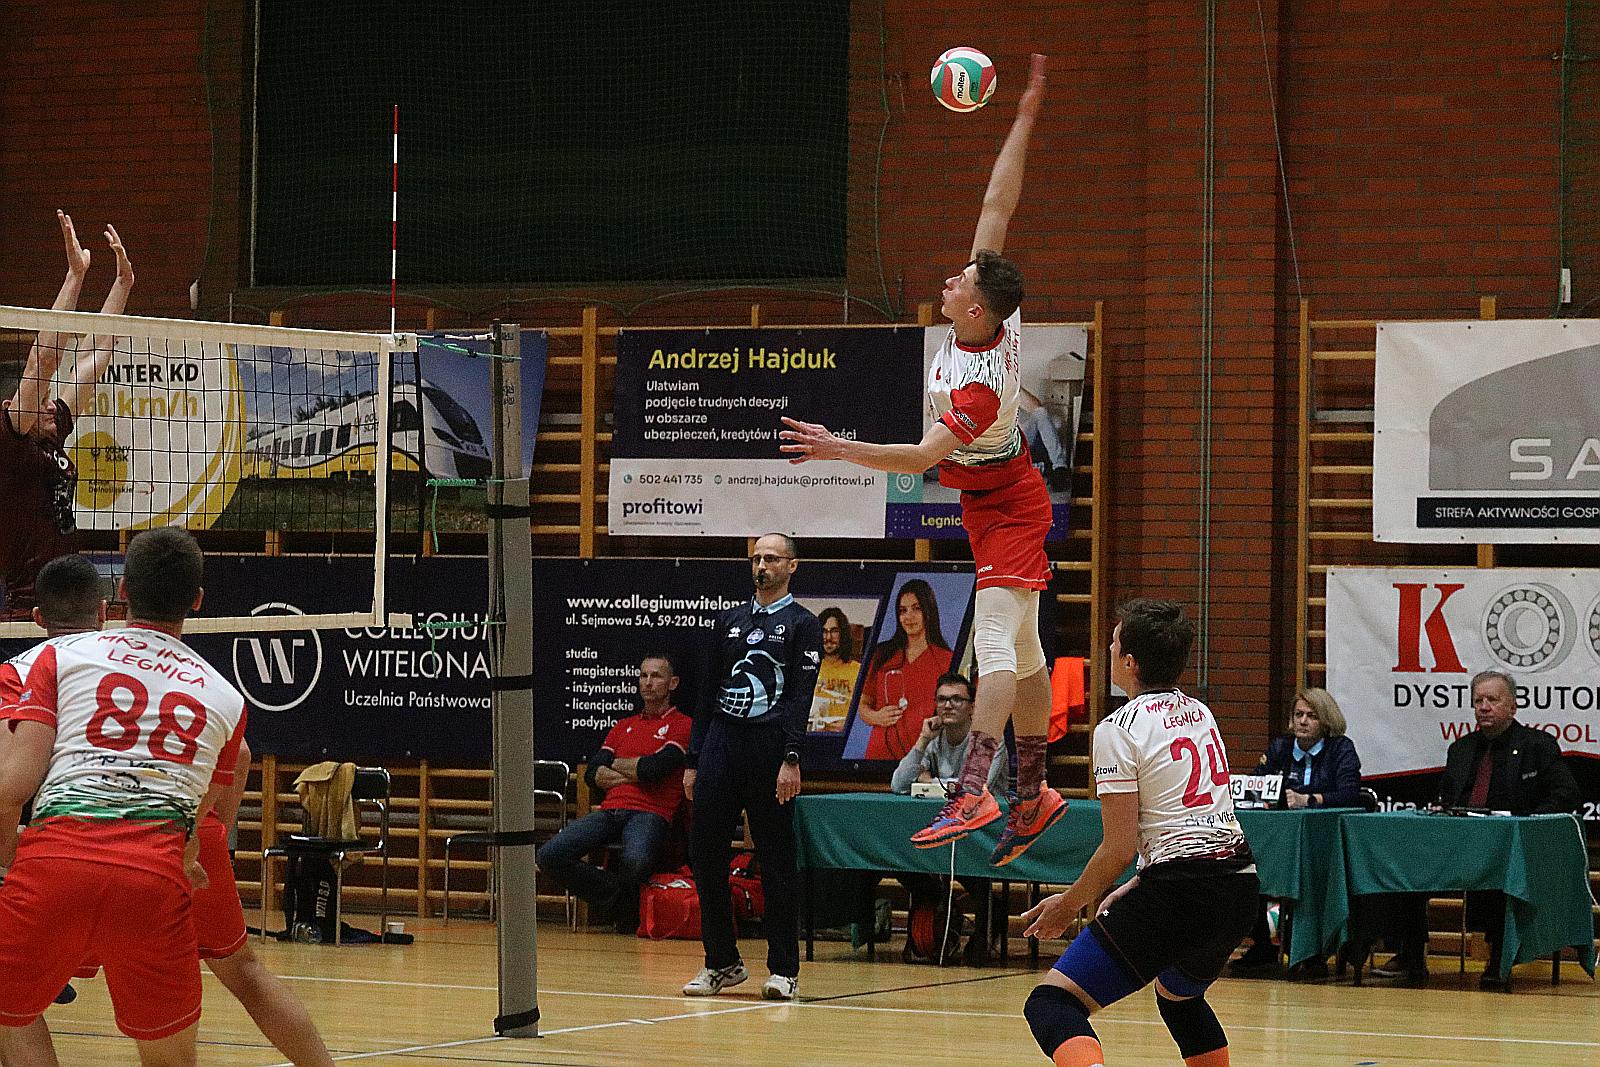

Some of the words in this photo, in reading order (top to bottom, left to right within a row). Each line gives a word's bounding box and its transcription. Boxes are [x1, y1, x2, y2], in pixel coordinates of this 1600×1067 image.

[957, 71, 966, 99] molten
[648, 348, 739, 373] Andrzej
[748, 348, 836, 373] Hajduk
[170, 363, 199, 383] KD
[646, 380, 700, 392] Ułatwiam
[645, 397, 696, 410] podjęcie
[698, 396, 747, 409] trudnych
[748, 396, 788, 410] decyzji
[644, 414, 654, 424] w
[656, 412, 708, 424] obszarze
[644, 428, 720, 442] ubezpieczeń,
[720, 428, 771, 442] kredytów
[773, 429, 778, 440] i
[640, 474, 661, 484] 502
[663, 474, 682, 484] 441
[683, 474, 703, 484] 735
[728, 475, 875, 487] andrzej.hajduk@profitowi.pl
[622, 498, 703, 517] profitowi
[1435, 507, 1475, 518] STREFA
[1477, 505, 1560, 518] AKTYWNOŚCI
[921, 514, 963, 529] Legnic
[565, 613, 579, 626] ul.
[581, 614, 632, 628] Sejmowa
[634, 615, 654, 628] 5A,
[657, 615, 696, 627] 59-220
[565, 646, 598, 659] studia
[107, 648, 206, 689] LEGNICA
[342, 649, 491, 679] WITELONA
[572, 664, 641, 679] magisterskie
[572, 681, 638, 696] inżynierskie
[344, 690, 403, 707] Uczelnia
[408, 692, 491, 709] Państwowa
[572, 697, 634, 714] licencjackie
[86, 671, 208, 765] 88
[1162, 708, 1207, 730] LEGNICA
[1169, 728, 1233, 809] 24
[1231, 779, 1243, 796] 13
[1266, 779, 1278, 796] 14
